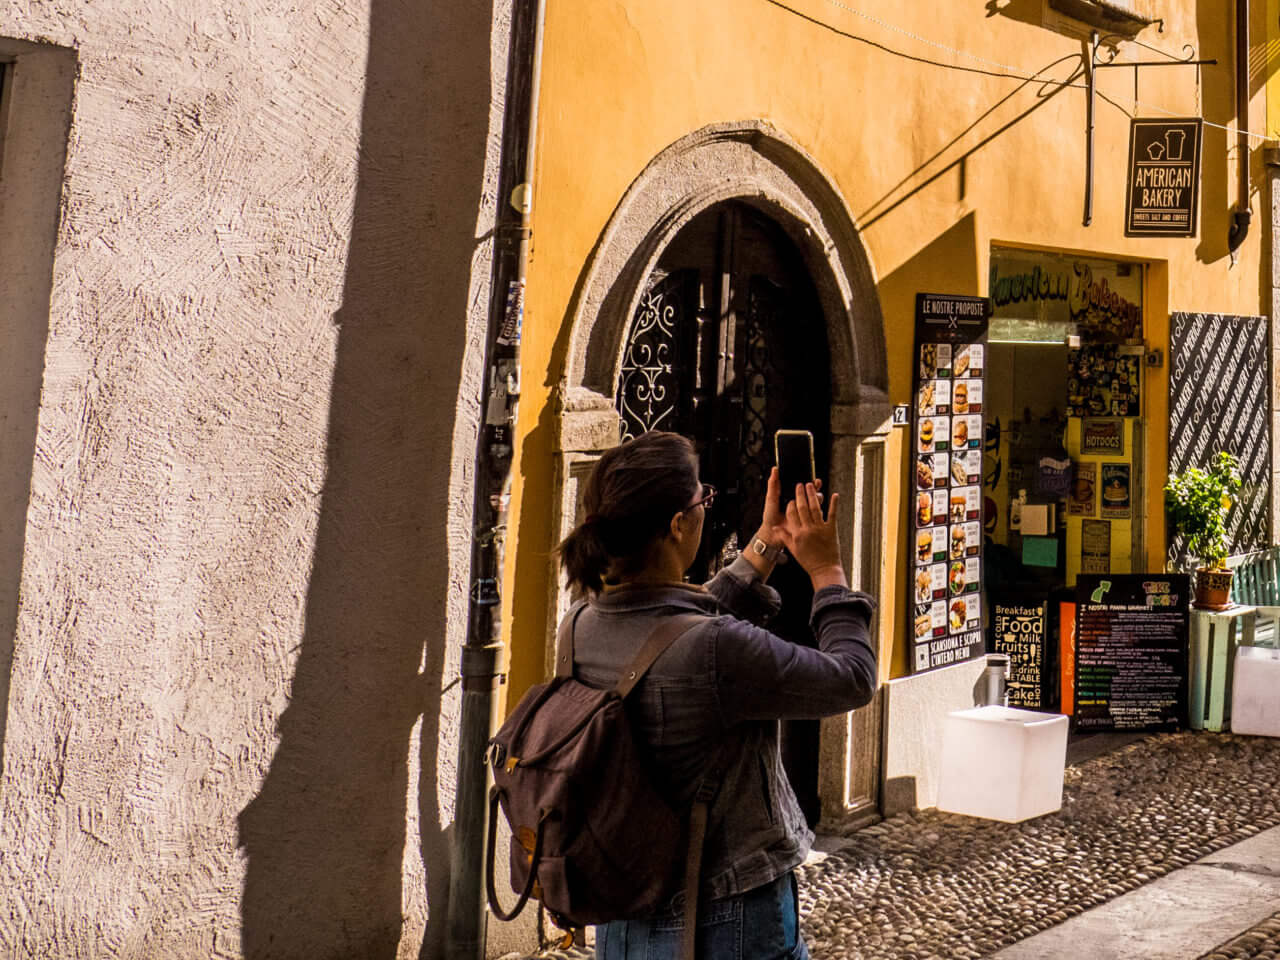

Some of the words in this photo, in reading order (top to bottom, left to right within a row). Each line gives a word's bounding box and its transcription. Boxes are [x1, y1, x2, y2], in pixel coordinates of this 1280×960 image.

[1136, 167, 1191, 188] AMERICAN
[1142, 189, 1182, 207] BAKERY
[923, 300, 930, 313] LE
[932, 301, 954, 314] NOSTRE
[955, 301, 983, 316] PROPOSTE
[995, 605, 1035, 616] Breakfast
[1002, 616, 1043, 634] Food
[930, 636, 958, 654] SCANSIONA
[960, 635, 964, 646] E
[964, 630, 981, 645] SCOPRI
[1019, 633, 1040, 643] Milk
[995, 640, 1029, 653] Fruits
[931, 649, 954, 667] L'INTERO
[1009, 653, 1022, 664] at
[1018, 665, 1040, 675] drink
[1007, 688, 1034, 700] Cake
